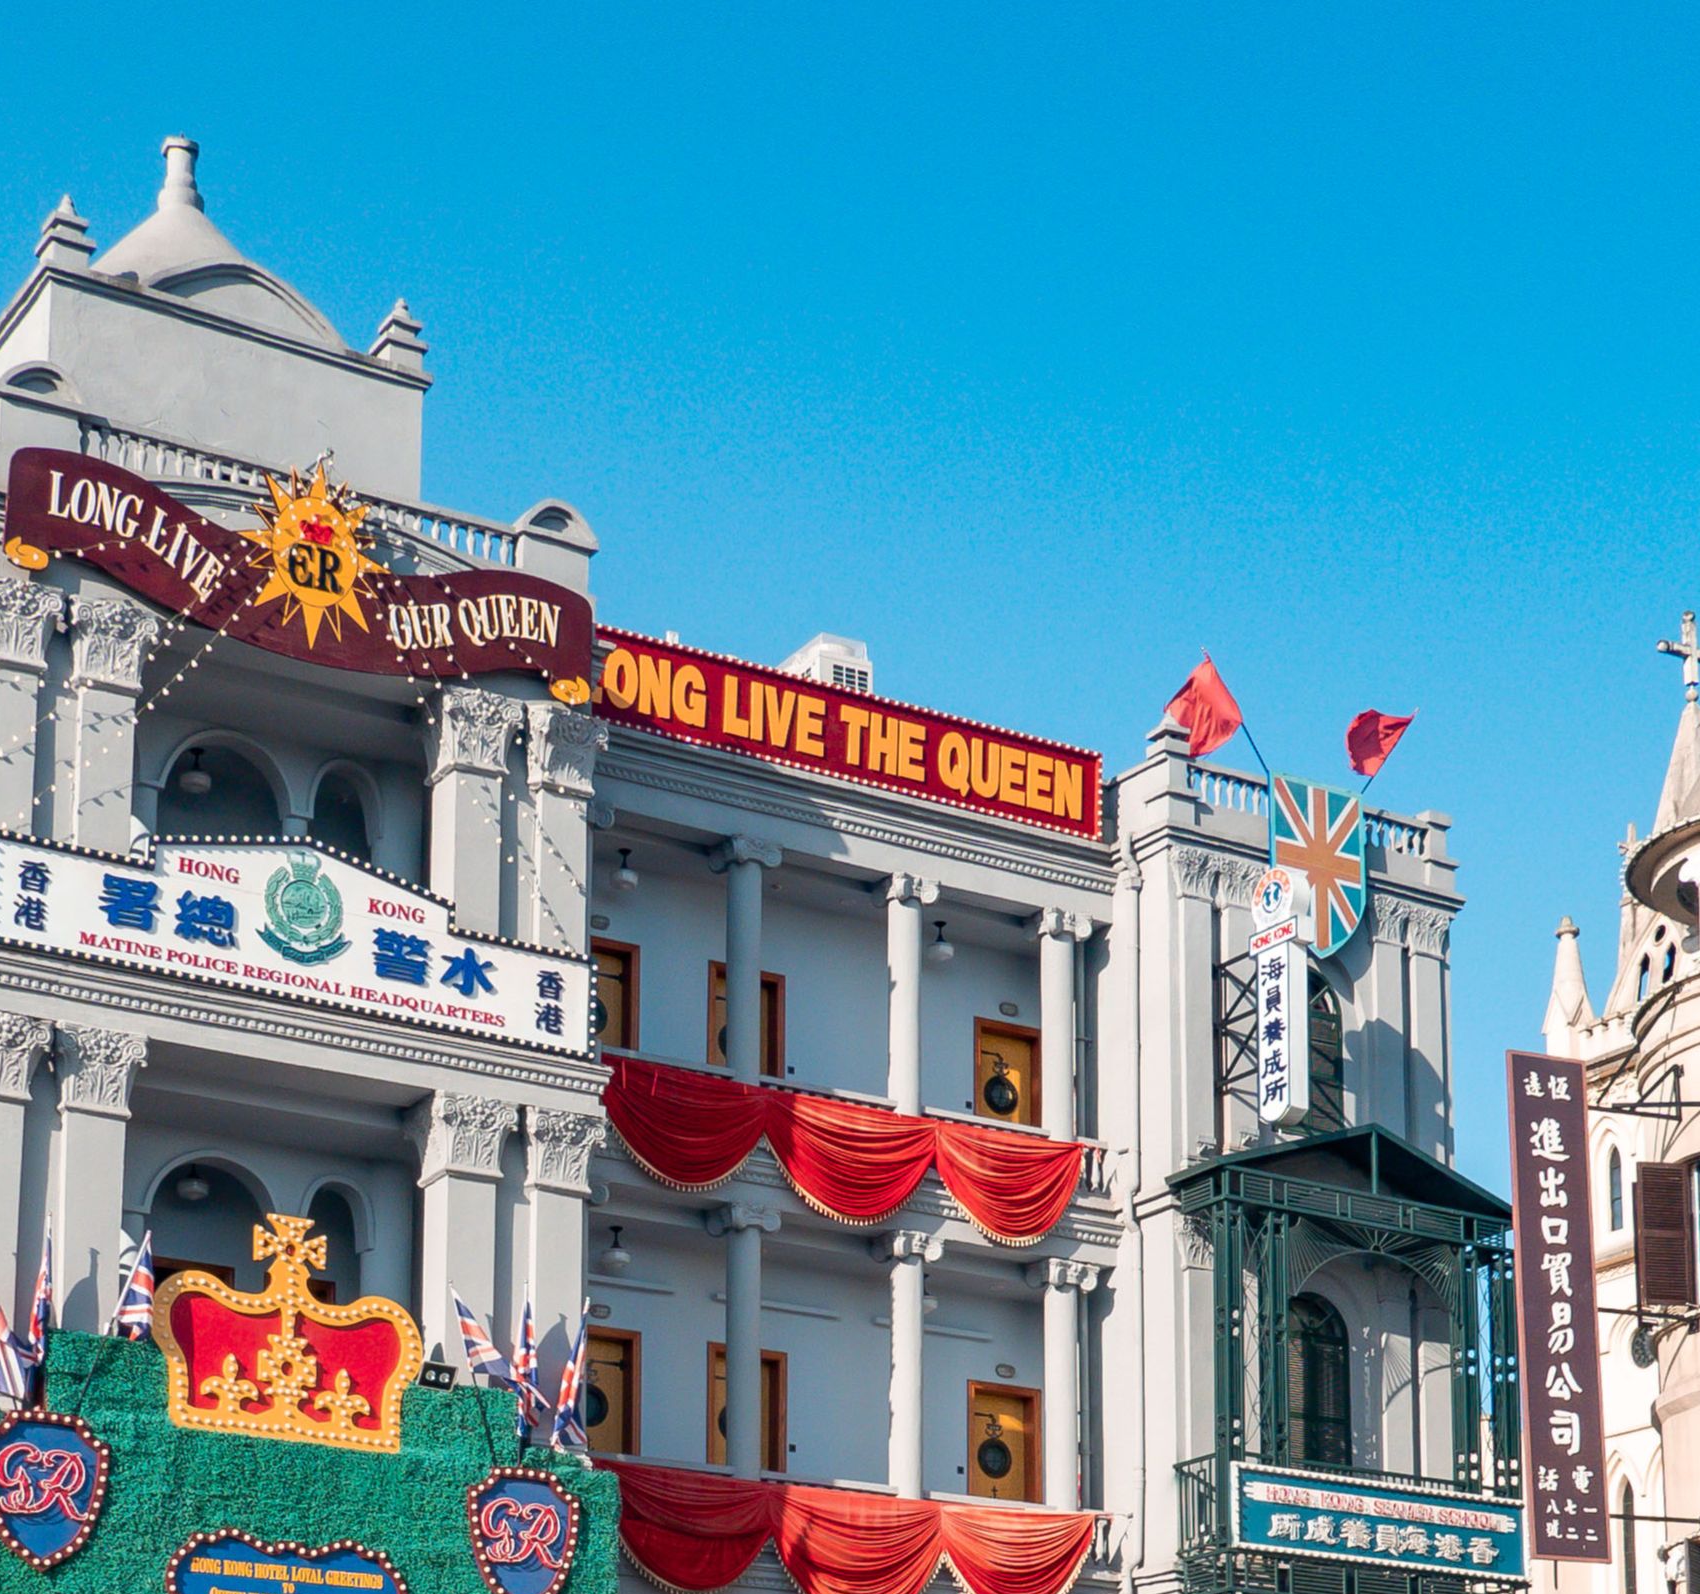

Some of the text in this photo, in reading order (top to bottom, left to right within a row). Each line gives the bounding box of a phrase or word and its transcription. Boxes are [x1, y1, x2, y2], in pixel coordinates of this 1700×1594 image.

[48, 470, 224, 601] LONG LIVE
[288, 545, 342, 593] ER
[389, 595, 560, 650] OUR QUEEN
[592, 648, 1084, 821] ONG LIVE THE QUEEN
[14, 860, 51, 931] 香港
[179, 858, 426, 922] HONG KONG
[1252, 923, 1293, 950] HONG KONG
[79, 931, 506, 1027] MATINE POLICE REGIONAL HEADQUARTERS
[534, 971, 567, 1035] 香港
[1262, 956, 1288, 1106] 海員養成所
[1530, 1120, 1583, 1457] 進出口貿易公司
[1266, 1485, 1310, 1505] HONG
[1321, 1492, 1364, 1512] KONG
[1439, 1509, 1498, 1531] SCHOOL
[190, 1557, 383, 1590] HONG KONG HOTEL LOYAL GREETINGS
[282, 1582, 295, 1594] TO
